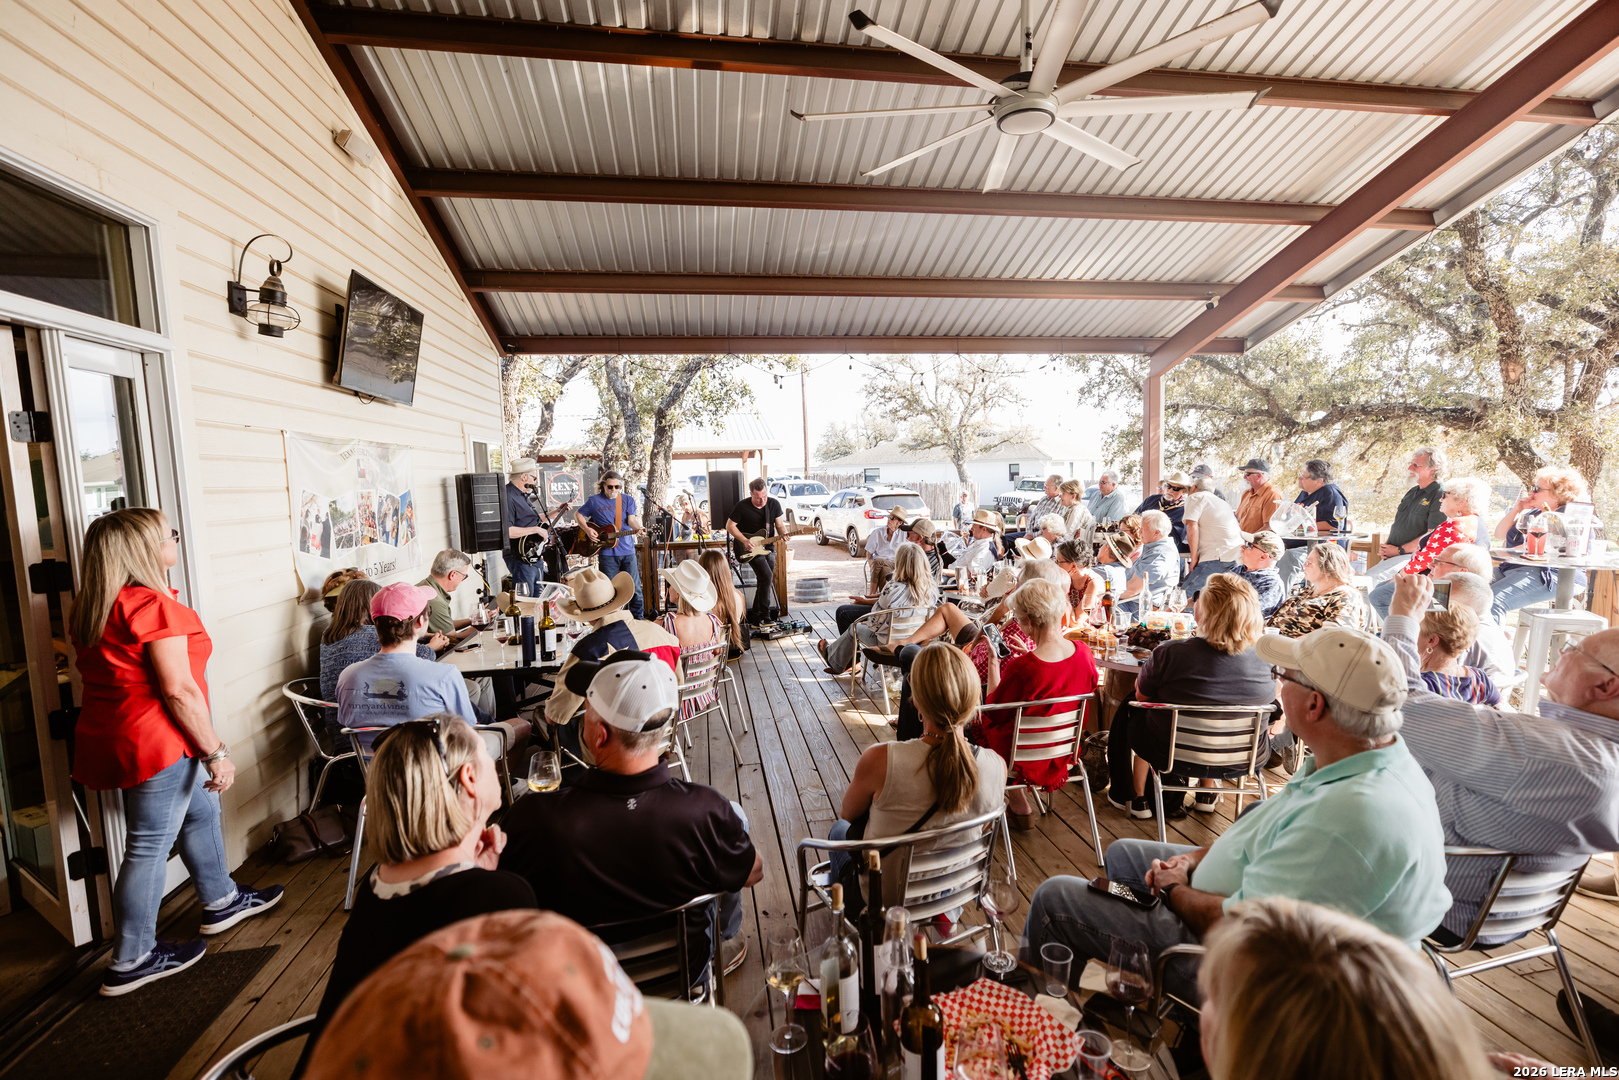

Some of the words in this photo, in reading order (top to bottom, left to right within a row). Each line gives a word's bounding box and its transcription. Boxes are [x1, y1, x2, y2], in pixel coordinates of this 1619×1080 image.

[373, 562, 379, 576] 5
[378, 557, 397, 574] Years!
[348, 702, 386, 711] vineyard
[386, 703, 410, 711] vines
